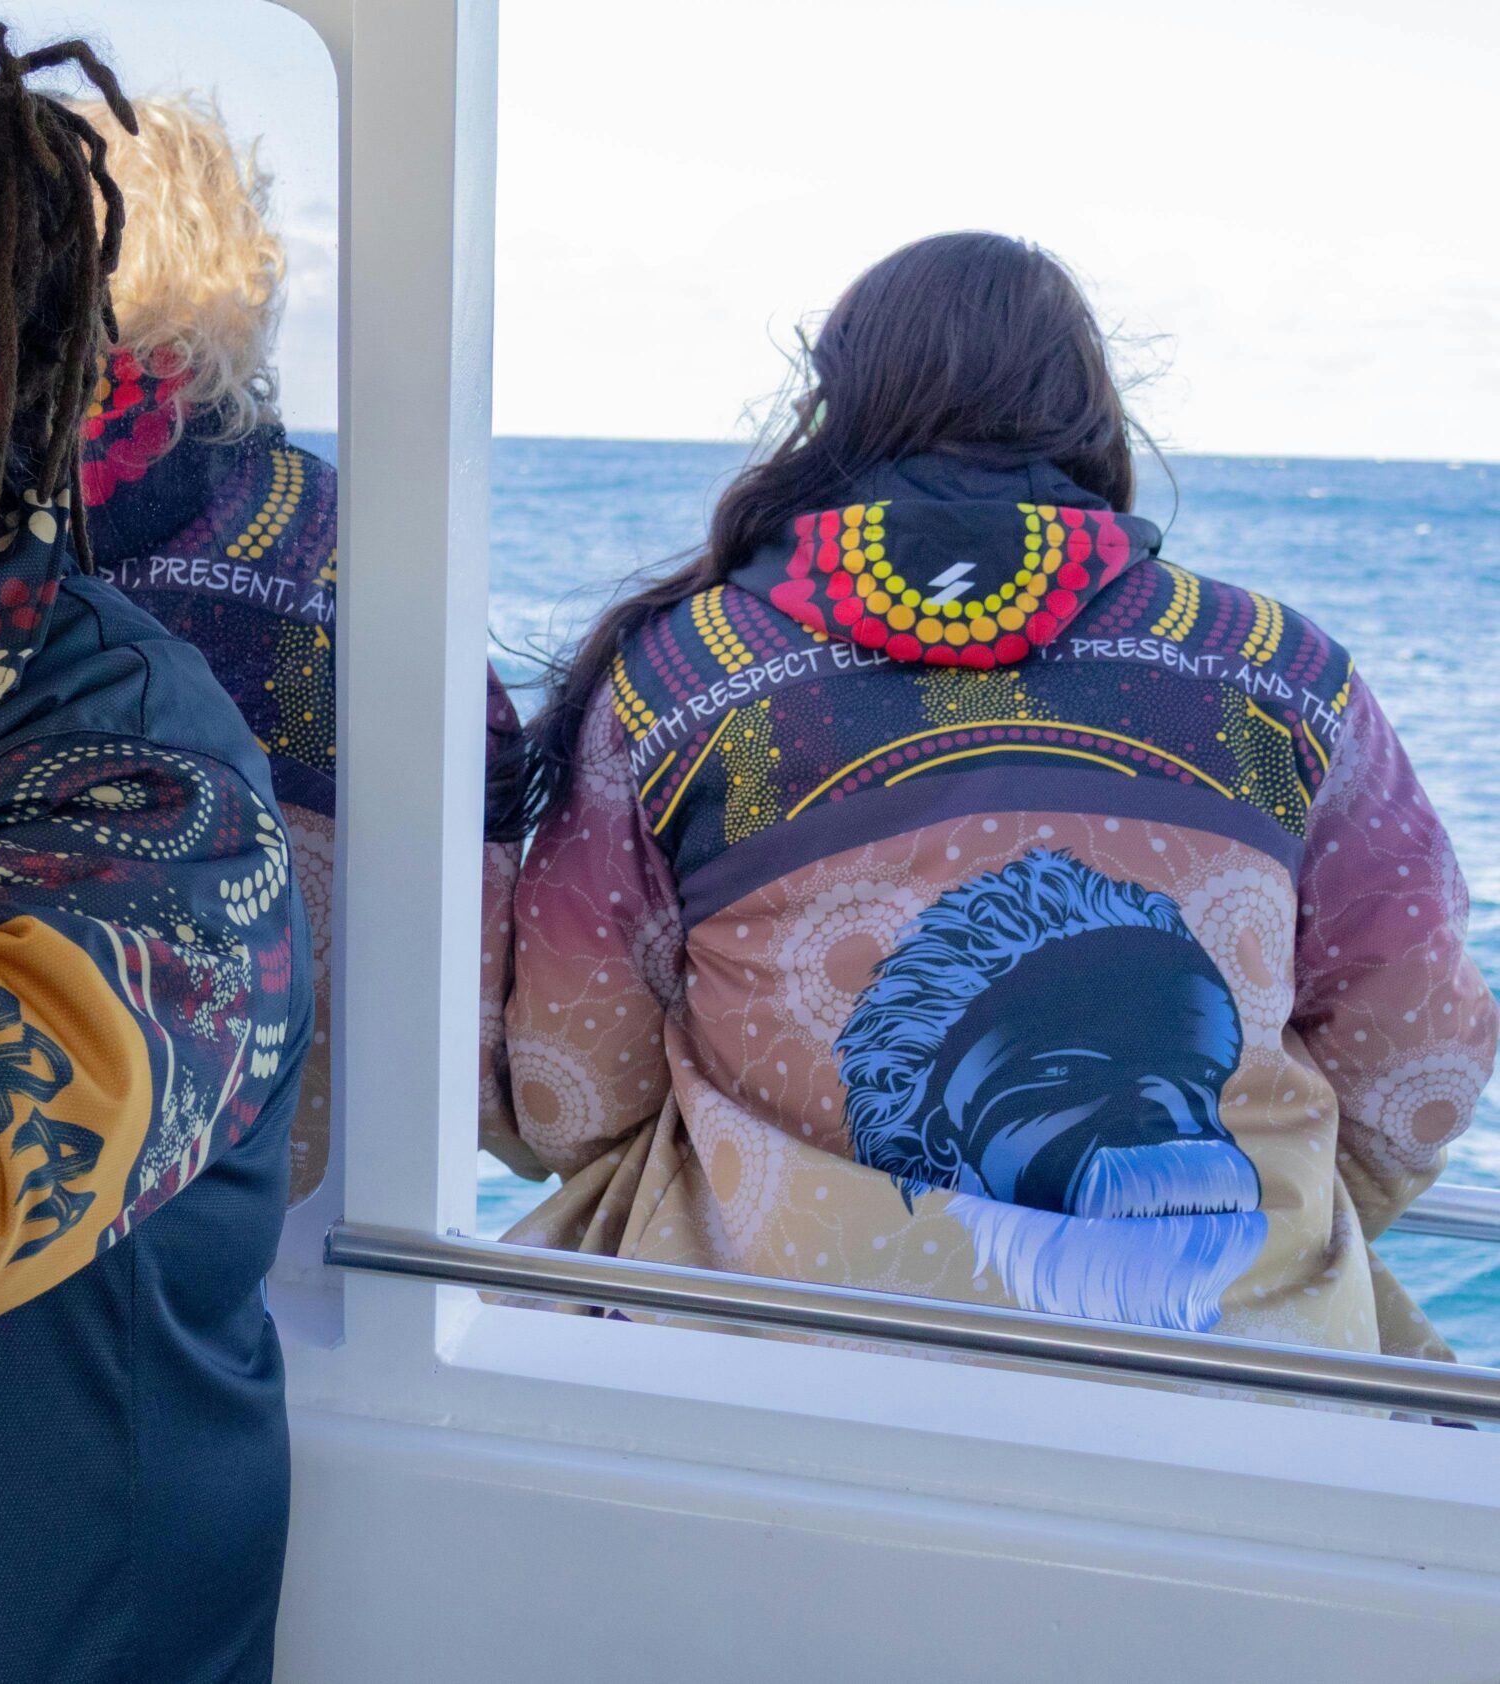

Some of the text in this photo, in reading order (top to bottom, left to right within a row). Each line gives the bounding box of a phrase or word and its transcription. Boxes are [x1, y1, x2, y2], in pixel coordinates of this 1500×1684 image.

[150, 555, 296, 612] PRESENT,
[687, 647, 825, 722] RESPECT
[1072, 637, 1229, 679] PRESENT,
[1236, 663, 1294, 700] AND
